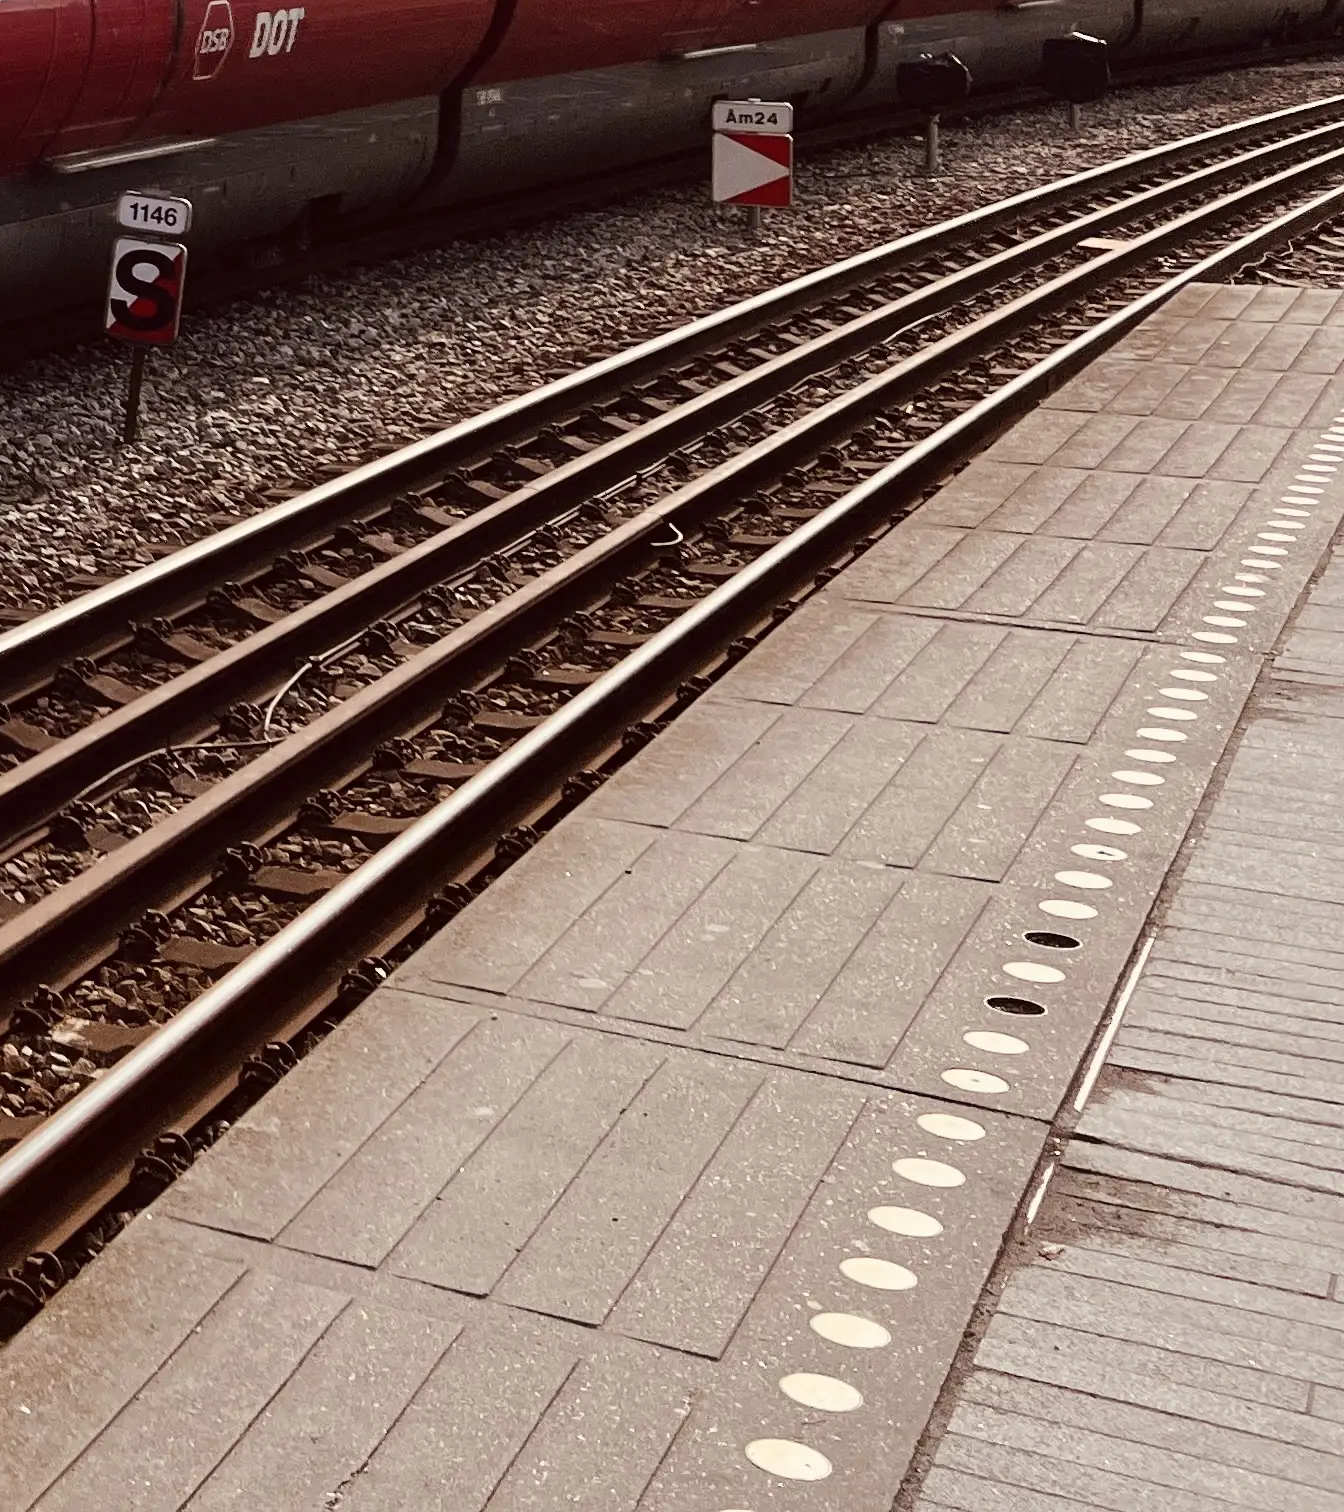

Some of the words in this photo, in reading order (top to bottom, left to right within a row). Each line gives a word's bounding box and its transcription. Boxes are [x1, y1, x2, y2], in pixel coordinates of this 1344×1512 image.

[199, 28, 230, 54] DSB
[248, 7, 305, 59] DOT
[129, 202, 178, 227] 1146
[110, 249, 176, 331] S
